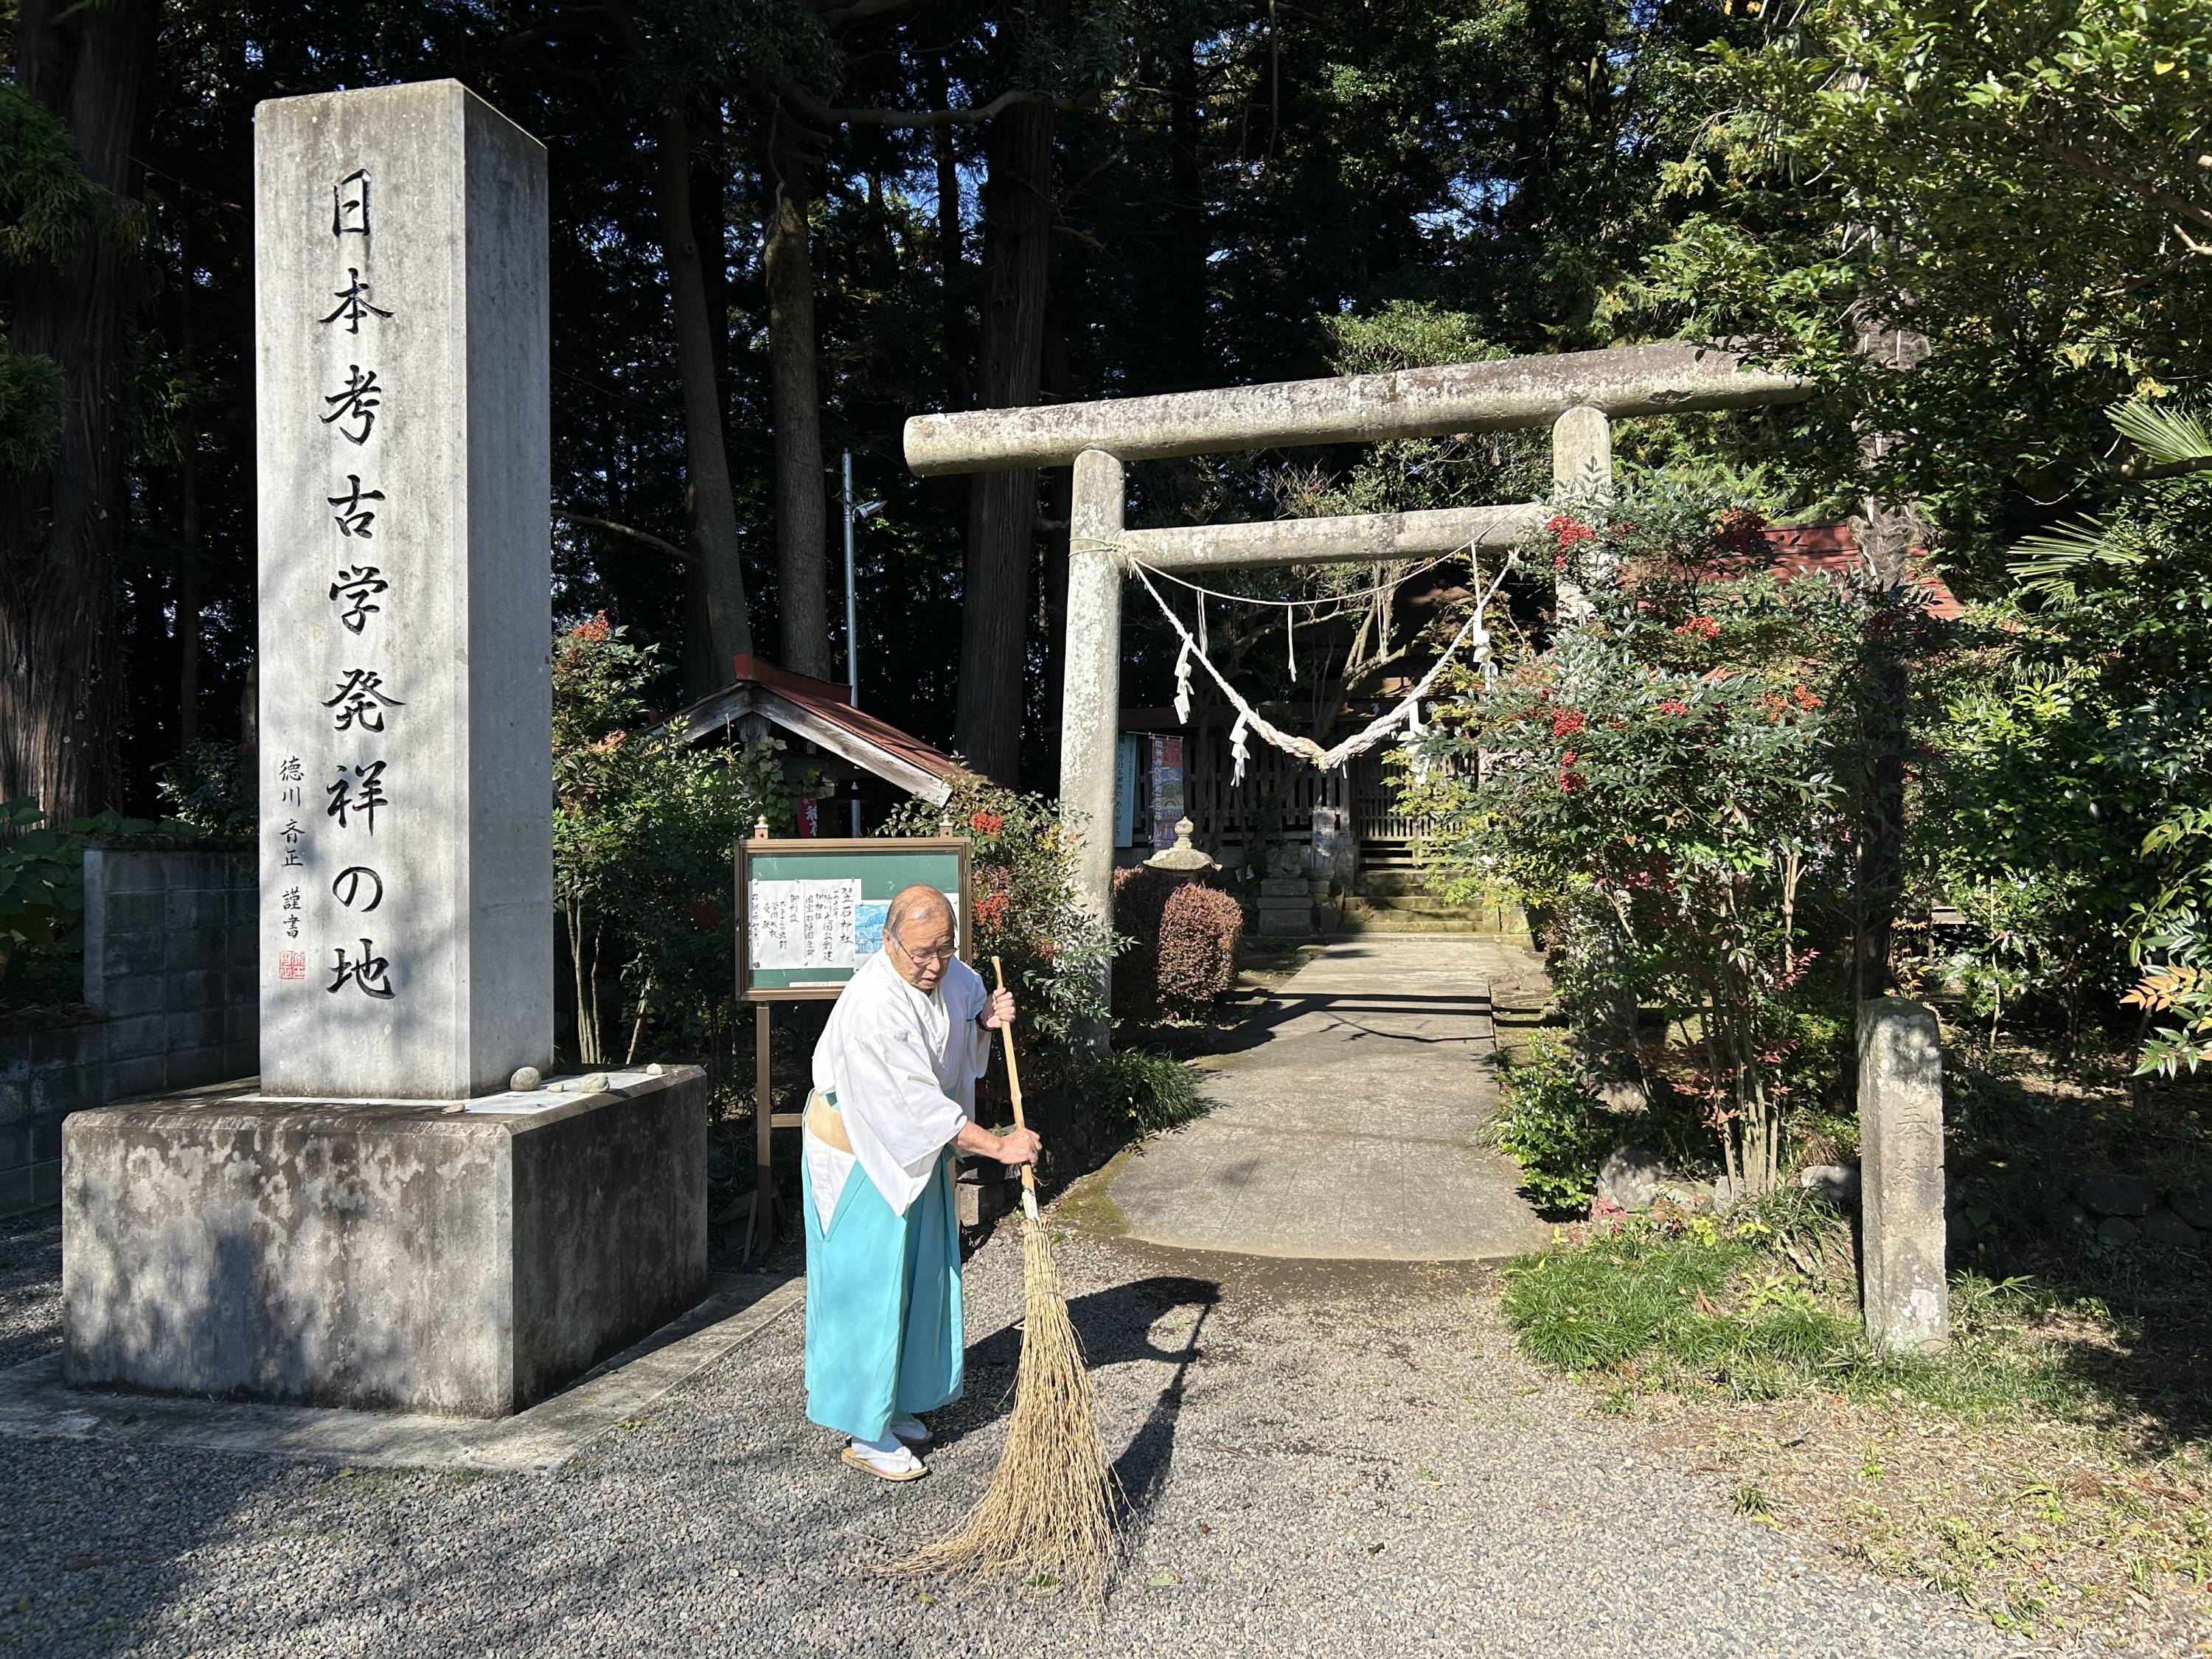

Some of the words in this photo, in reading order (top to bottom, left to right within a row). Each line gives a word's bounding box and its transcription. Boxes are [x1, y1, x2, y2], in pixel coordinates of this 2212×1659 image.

[319, 169, 406, 999] 日本考古学発祥の地
[841, 888, 855, 943] 笠石神社
